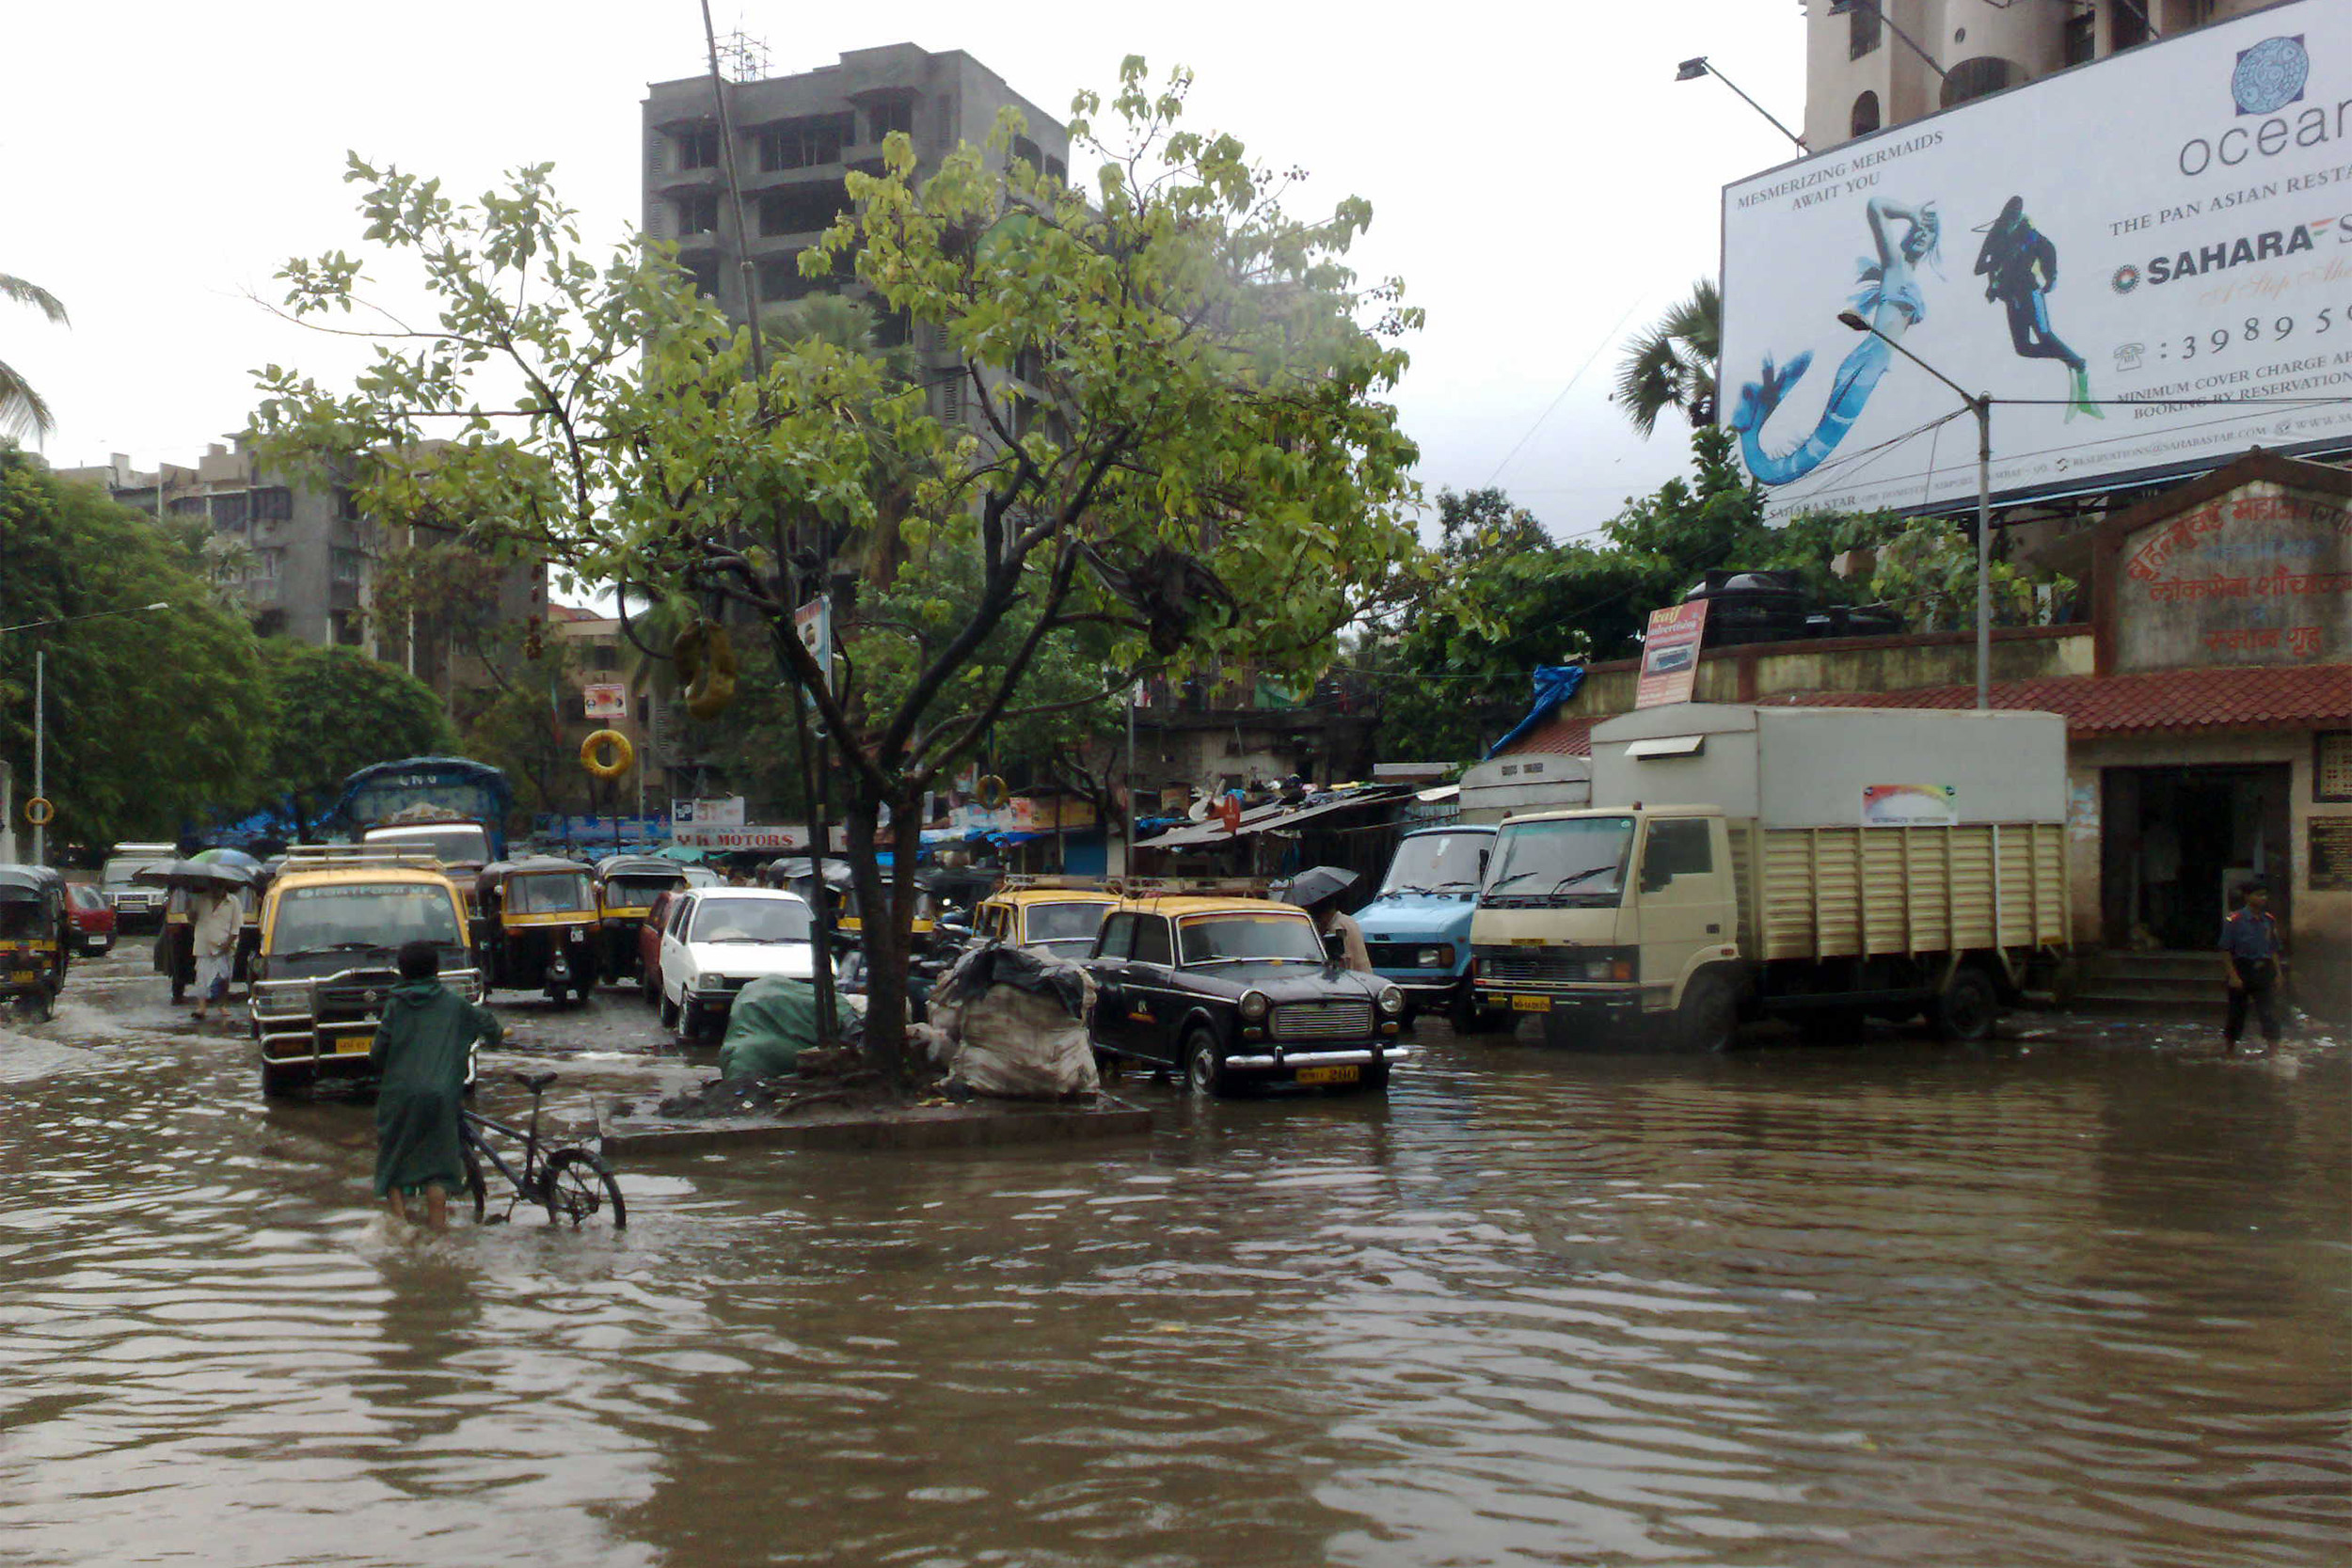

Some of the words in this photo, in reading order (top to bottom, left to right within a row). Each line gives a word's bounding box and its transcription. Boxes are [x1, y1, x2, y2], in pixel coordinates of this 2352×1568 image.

[1738, 162, 1846, 210] MESMERIZING
[1851, 130, 1944, 173] MERMAIDS
[1792, 184, 1838, 211] AWAIT
[1847, 171, 1881, 194] YOU
[2110, 214, 2152, 236] THE
[2159, 200, 2202, 225] PAN
[2210, 182, 2279, 212] ASIAN
[2147, 223, 2314, 285] SAHARA
[2117, 381, 2190, 404] MINIMUM
[2194, 369, 2250, 391] COVER
[2255, 355, 2328, 378] CHARGE
[2133, 395, 2208, 420] BOOKING
[2214, 390, 2235, 404] BY
[1823, 495, 1857, 510] STAR
[718, 833, 794, 847] MOTORS
